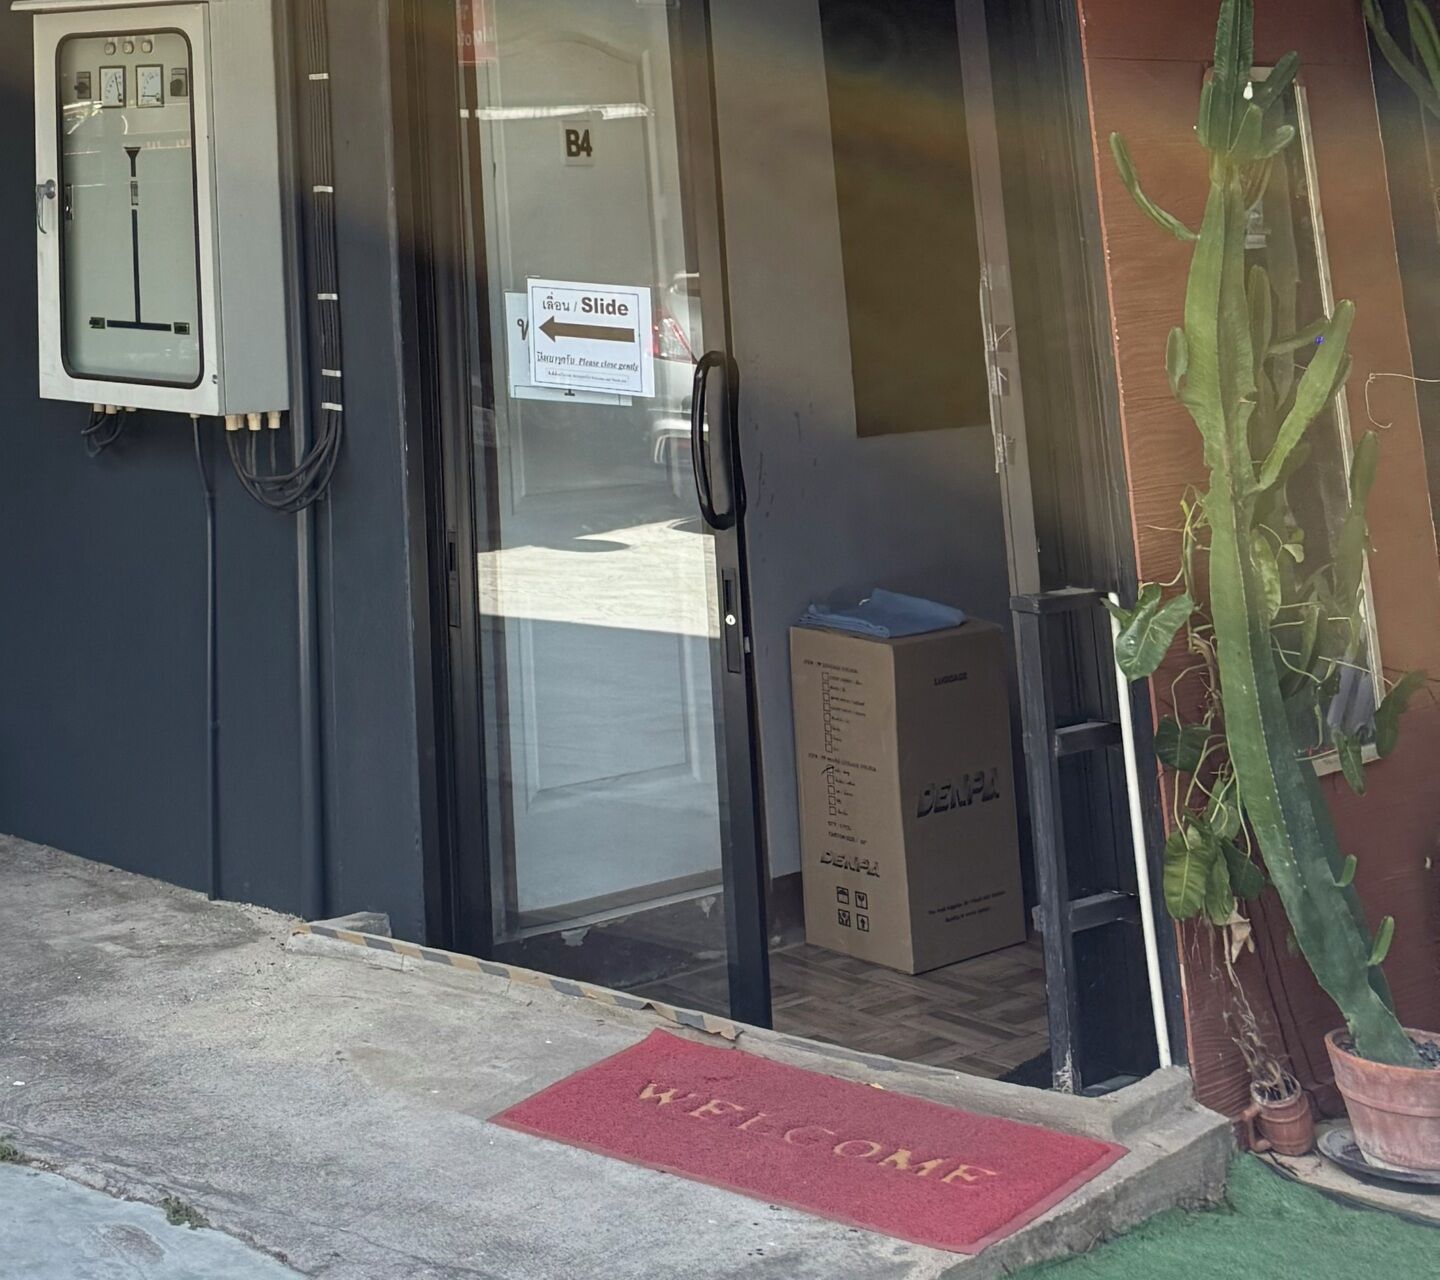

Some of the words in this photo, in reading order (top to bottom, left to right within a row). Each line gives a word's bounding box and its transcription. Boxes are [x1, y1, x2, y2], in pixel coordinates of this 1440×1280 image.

[565, 129, 593, 157] B4
[542, 291, 570, 312] เลื่อน
[581, 297, 629, 316] Slide
[638, 1079, 1000, 1187] WELCOME
